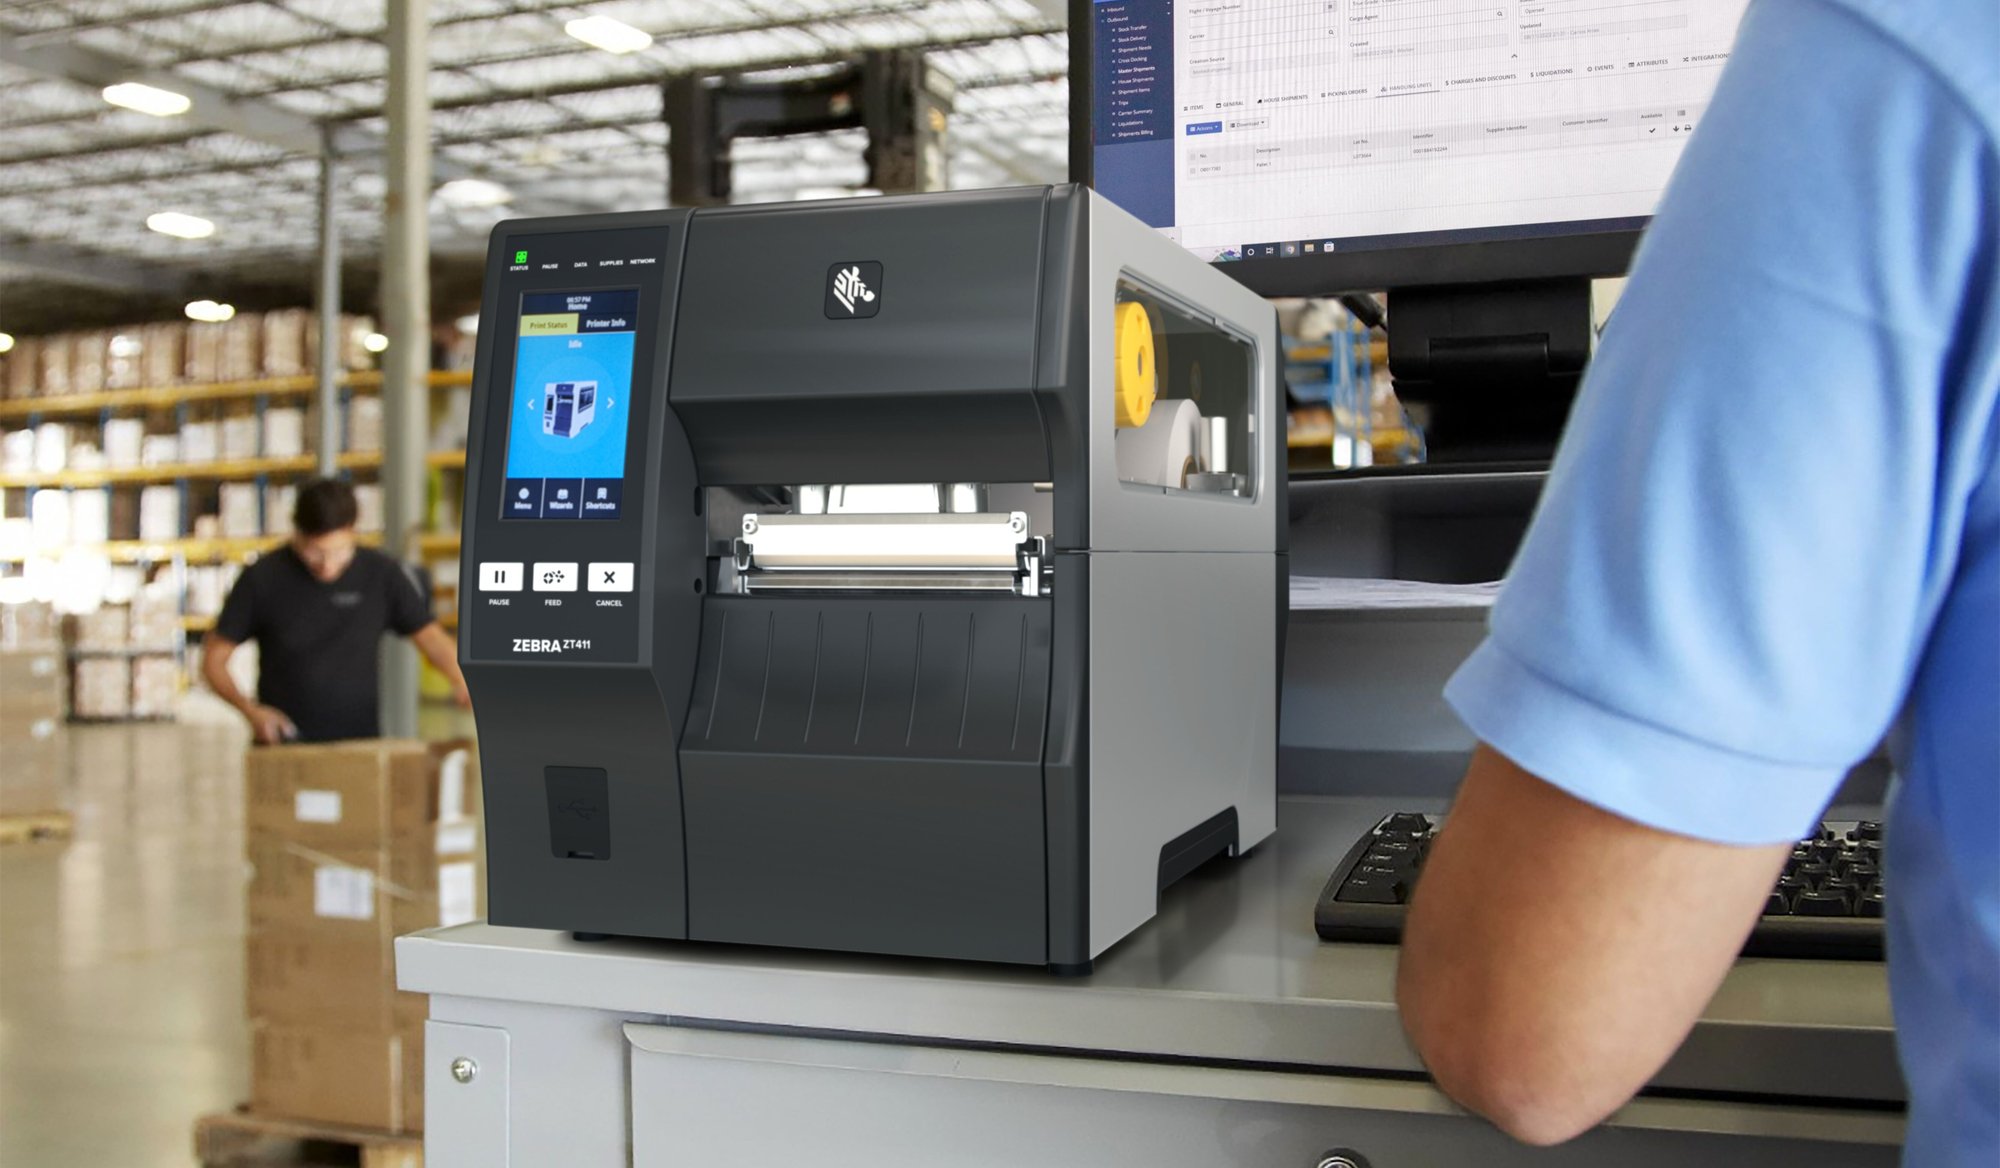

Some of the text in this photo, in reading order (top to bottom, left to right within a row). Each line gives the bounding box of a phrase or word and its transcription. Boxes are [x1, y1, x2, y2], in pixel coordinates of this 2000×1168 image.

[1637, 59, 1668, 67] ATTRIBUTES
[1536, 69, 1573, 77] LIQUIDATIONS
[530, 321, 568, 330] Print Status
[586, 318, 626, 328] Printer Info
[568, 340, 582, 348] Idle
[514, 502, 532, 510] Menu
[549, 501, 574, 510] Wizards
[585, 501, 616, 510] Shortcuts
[512, 639, 591, 652] ZEBRA ZT411
